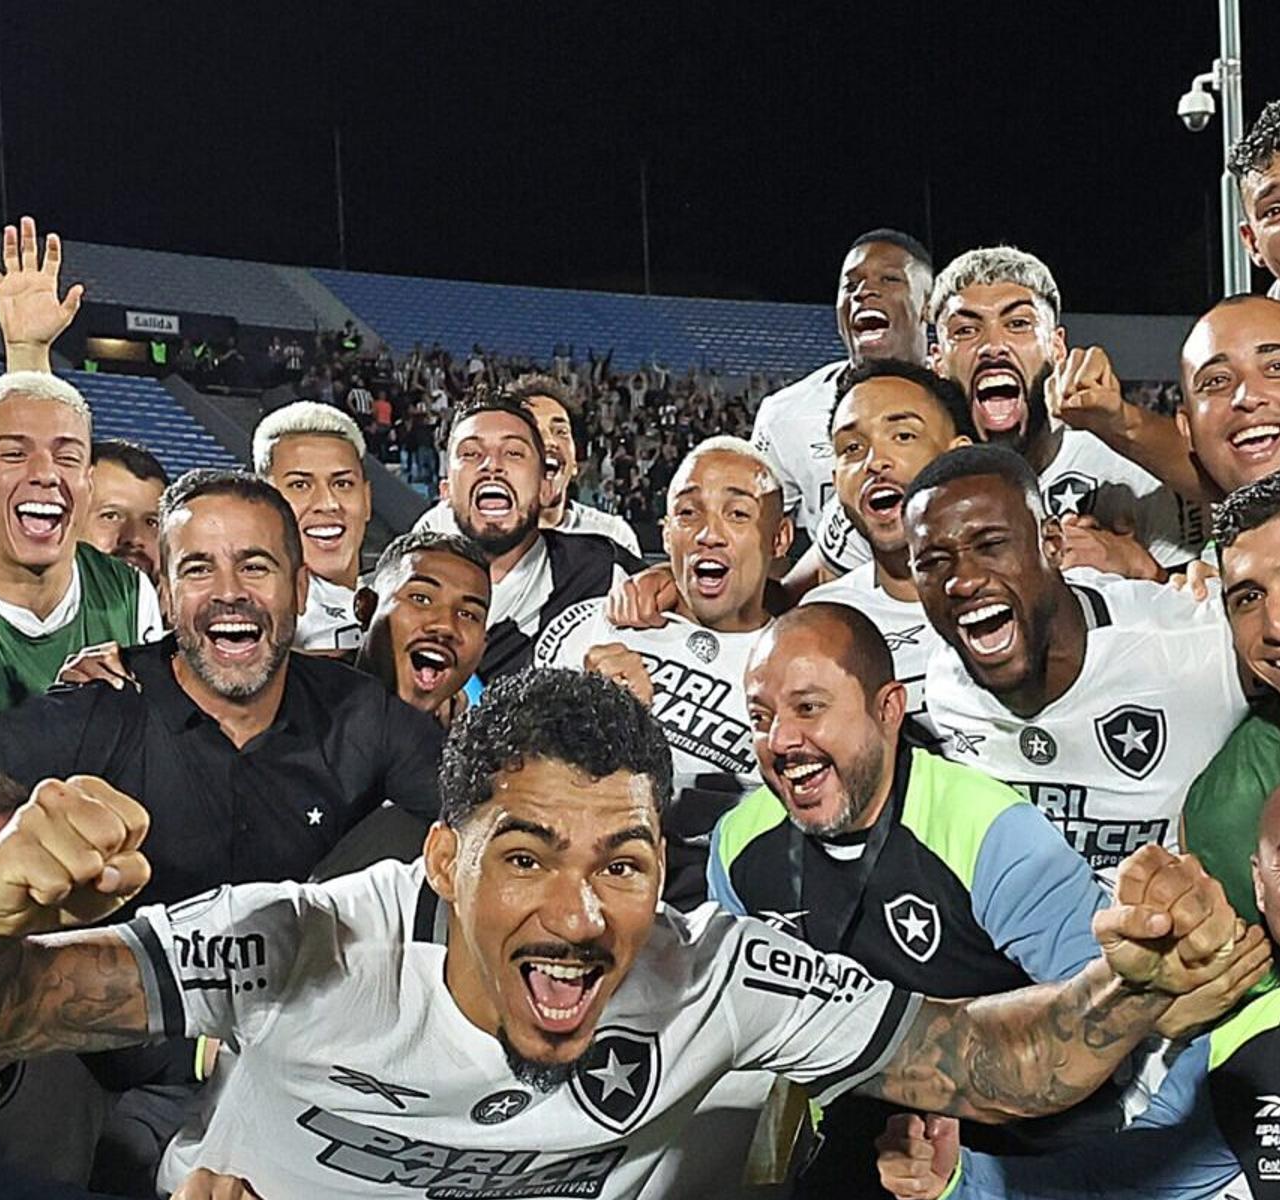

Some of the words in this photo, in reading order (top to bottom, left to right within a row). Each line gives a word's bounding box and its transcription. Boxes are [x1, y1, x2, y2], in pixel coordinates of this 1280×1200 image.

[133, 314, 173, 330] Salida
[537, 603, 595, 669] entrum
[650, 691, 758, 764] ATCH
[1053, 820, 1164, 853] TCH
[303, 1110, 538, 1176] PARI
[326, 1150, 620, 1190] MATCH
